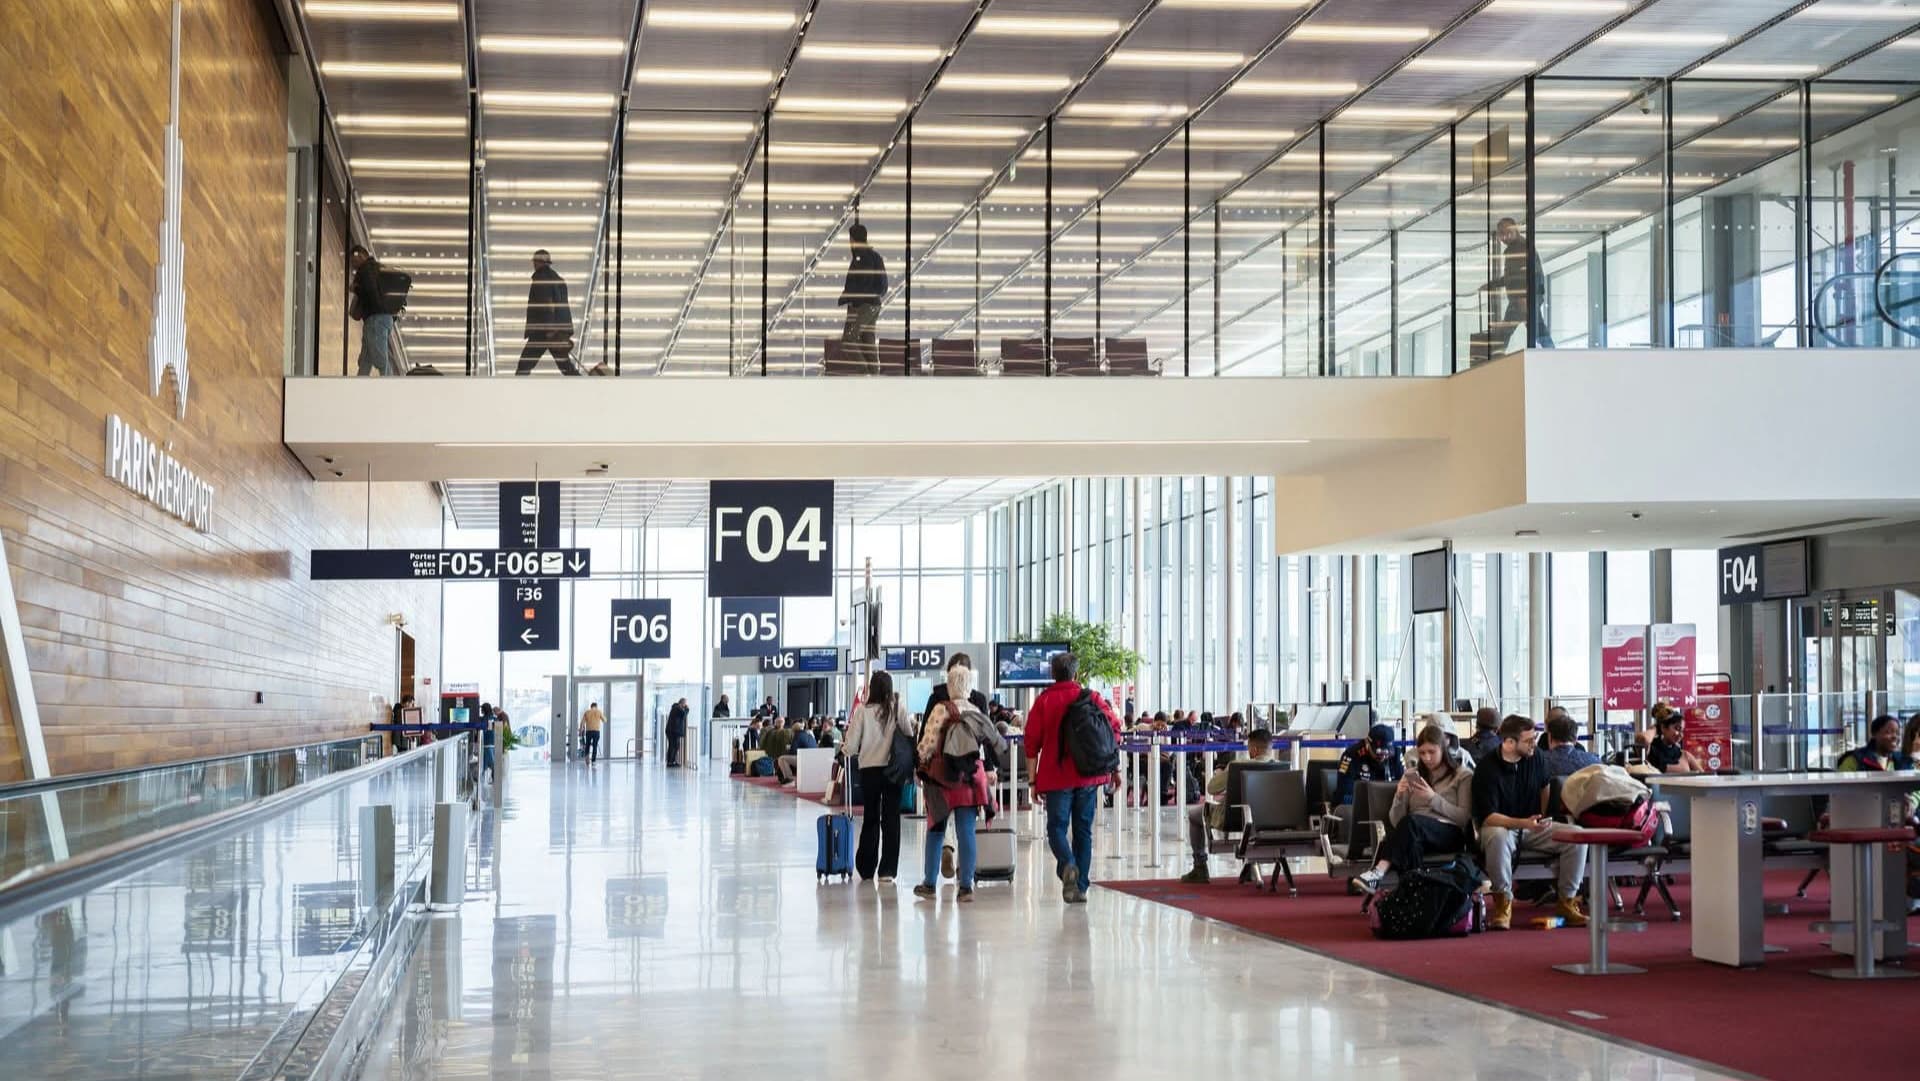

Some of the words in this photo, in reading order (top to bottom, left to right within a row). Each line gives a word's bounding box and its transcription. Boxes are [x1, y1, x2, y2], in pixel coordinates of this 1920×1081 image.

[715, 505, 827, 563] F04
[409, 552, 436, 560] Portes
[412, 560, 436, 568] Gates
[1723, 554, 1758, 595] F04
[516, 586, 543, 602] F36
[613, 614, 668, 645] F06
[723, 612, 777, 641] F05
[910, 649, 941, 666] F05
